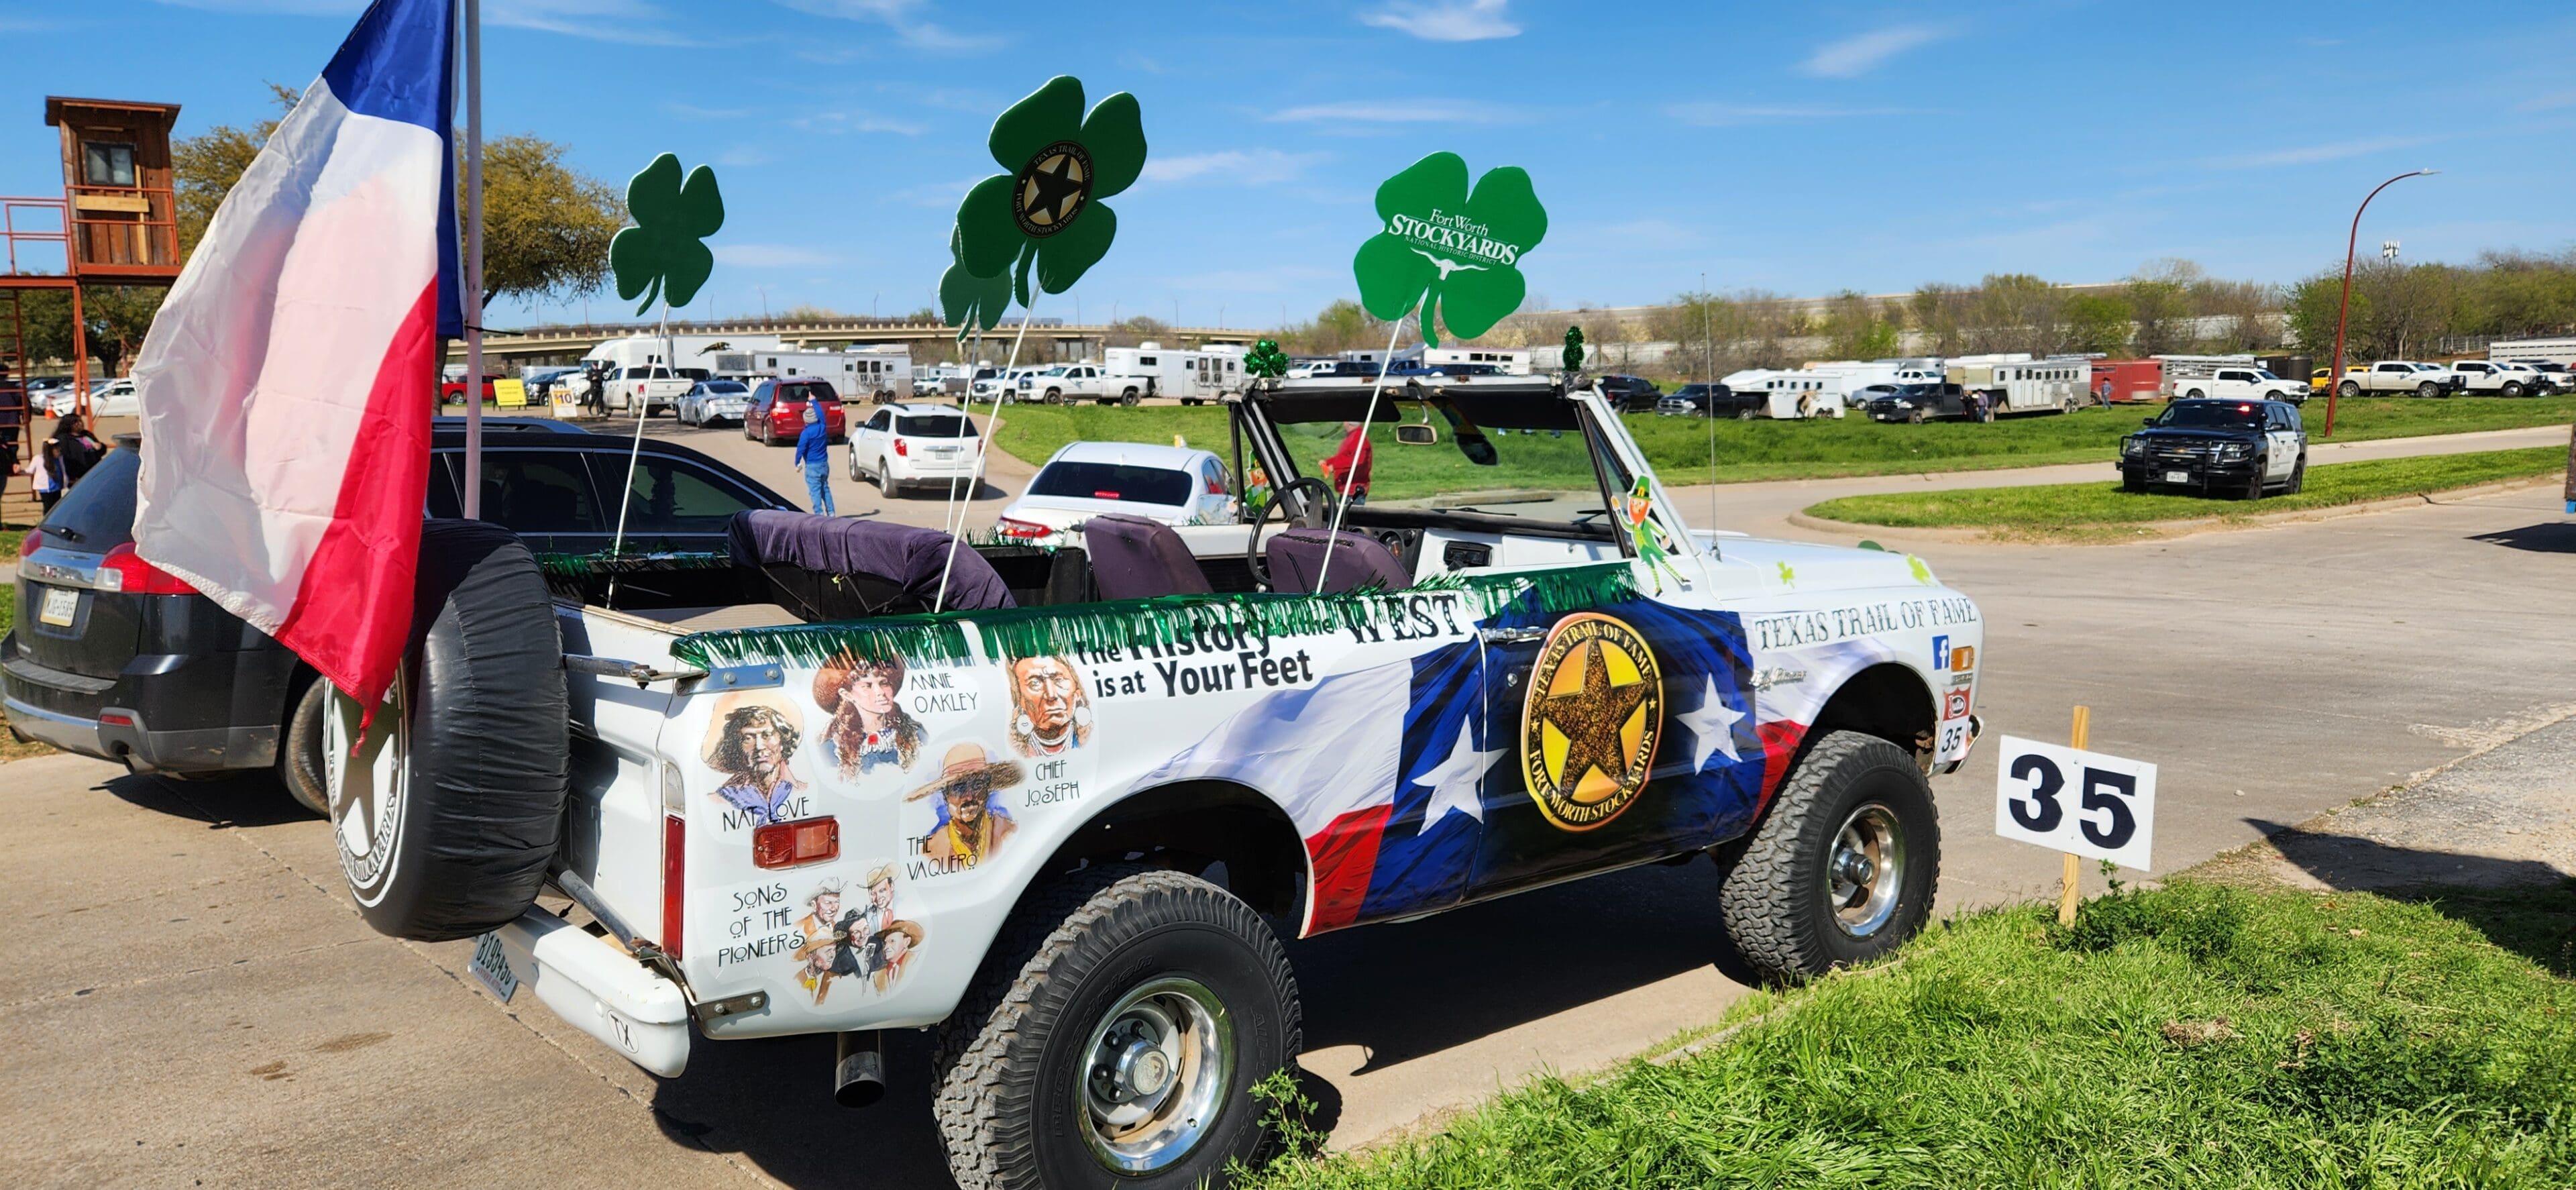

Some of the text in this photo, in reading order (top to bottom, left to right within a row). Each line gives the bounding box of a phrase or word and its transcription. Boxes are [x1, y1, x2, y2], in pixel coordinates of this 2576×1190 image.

[1034, 145, 1091, 181] TEXAS TRAIL OF FAME
[1014, 193, 1078, 234] FORT WORTH STOCKYARDS
[1429, 208, 1489, 237] Fort Worth
[1388, 213, 1520, 265] STOCKYARDS
[1405, 235, 1497, 266] NATIONAL HISTORIC DISTRICT
[1340, 594, 1464, 644] WEST
[1755, 597, 1977, 650] TEXAS TRAIL OF FAME
[1093, 648, 1313, 698] is at Your Feet
[1536, 621, 1652, 695] TEXAS TRAIL OF FAME
[910, 672, 955, 692] ANNIE
[914, 692, 978, 714] OAKLEY
[1941, 726, 1963, 753] 35
[1035, 759, 1067, 781] CHIEF
[1529, 729, 1654, 822] FORT WORTH STOCKYARDS
[1025, 781, 1080, 808] JOSEPH
[2008, 754, 2137, 849] 35
[722, 796, 810, 832] NAT LOVE
[355, 793, 396, 881] STOCKYARDS
[906, 834, 932, 857] THE
[907, 853, 978, 881] VAQUERO
[733, 881, 788, 912] SONS
[729, 907, 792, 939] OF THE
[718, 930, 806, 968] PIONEERS
[610, 1014, 635, 1051] TX
